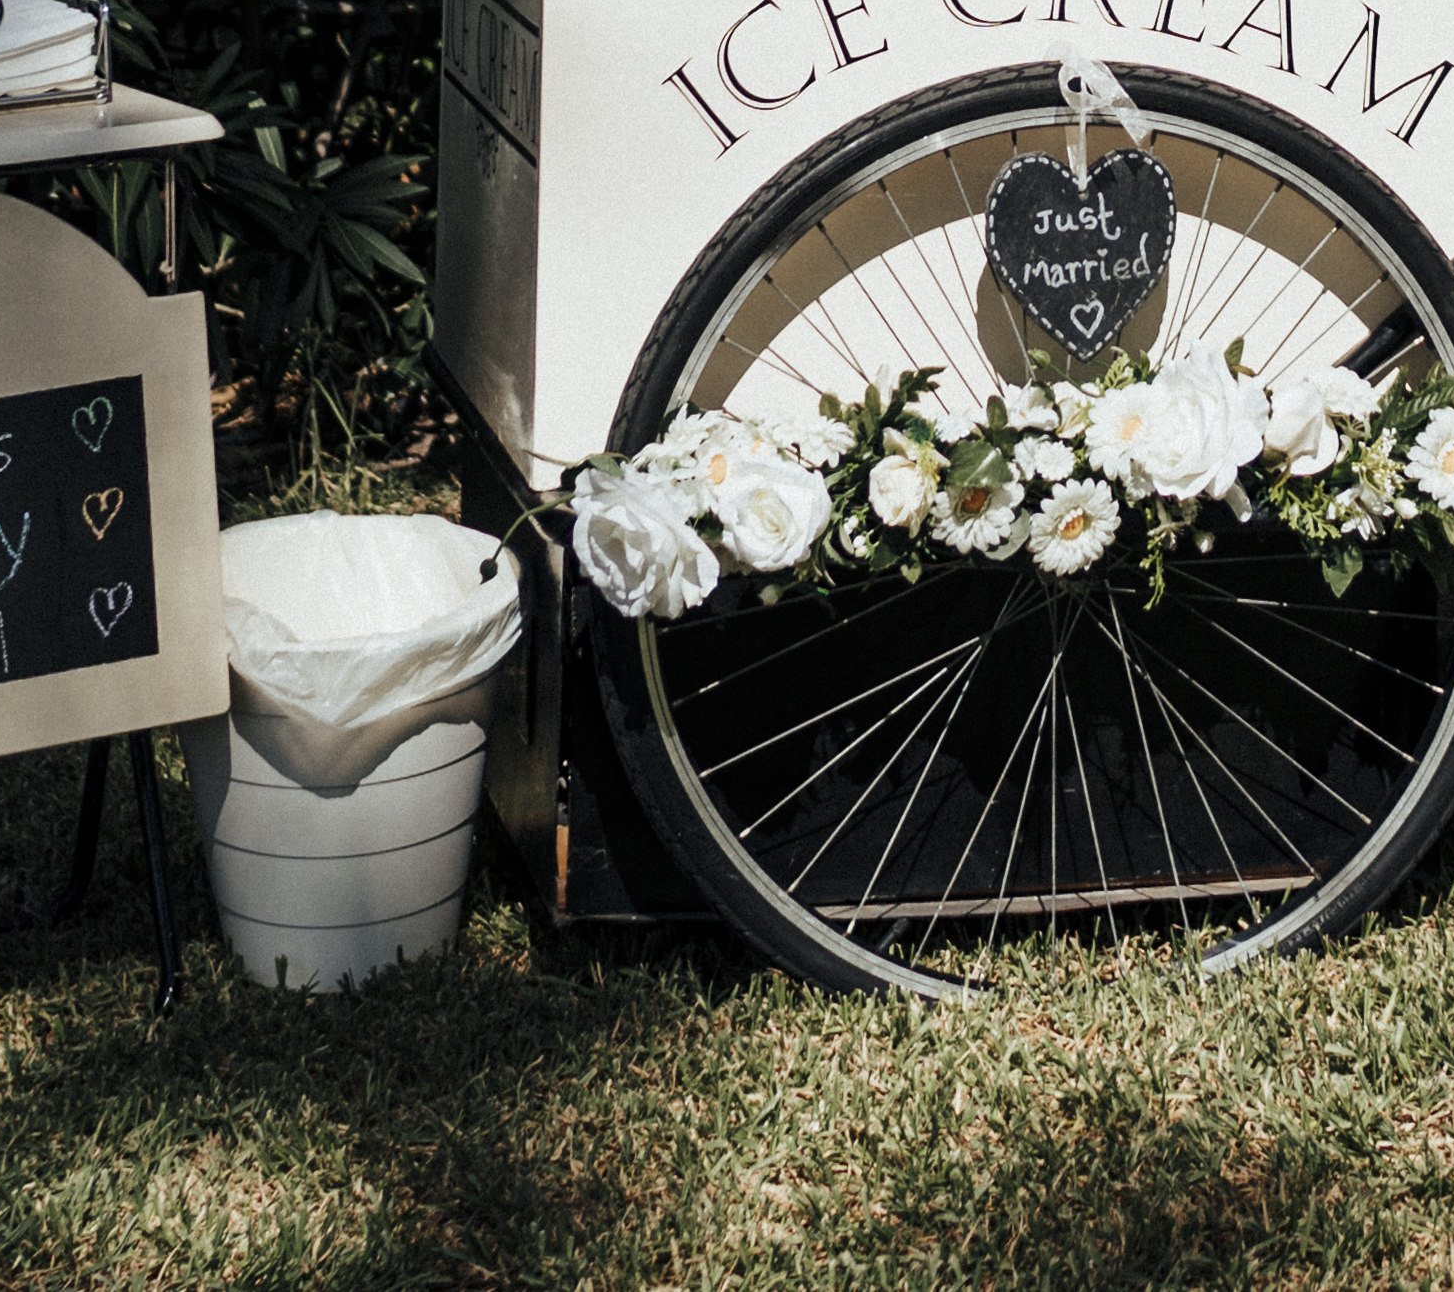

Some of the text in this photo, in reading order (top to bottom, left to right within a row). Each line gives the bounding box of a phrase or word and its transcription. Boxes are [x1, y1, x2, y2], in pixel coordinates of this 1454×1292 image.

[476, 2, 539, 147] CREAM
[1033, 191, 1121, 240] Just
[1023, 231, 1151, 288] Married
